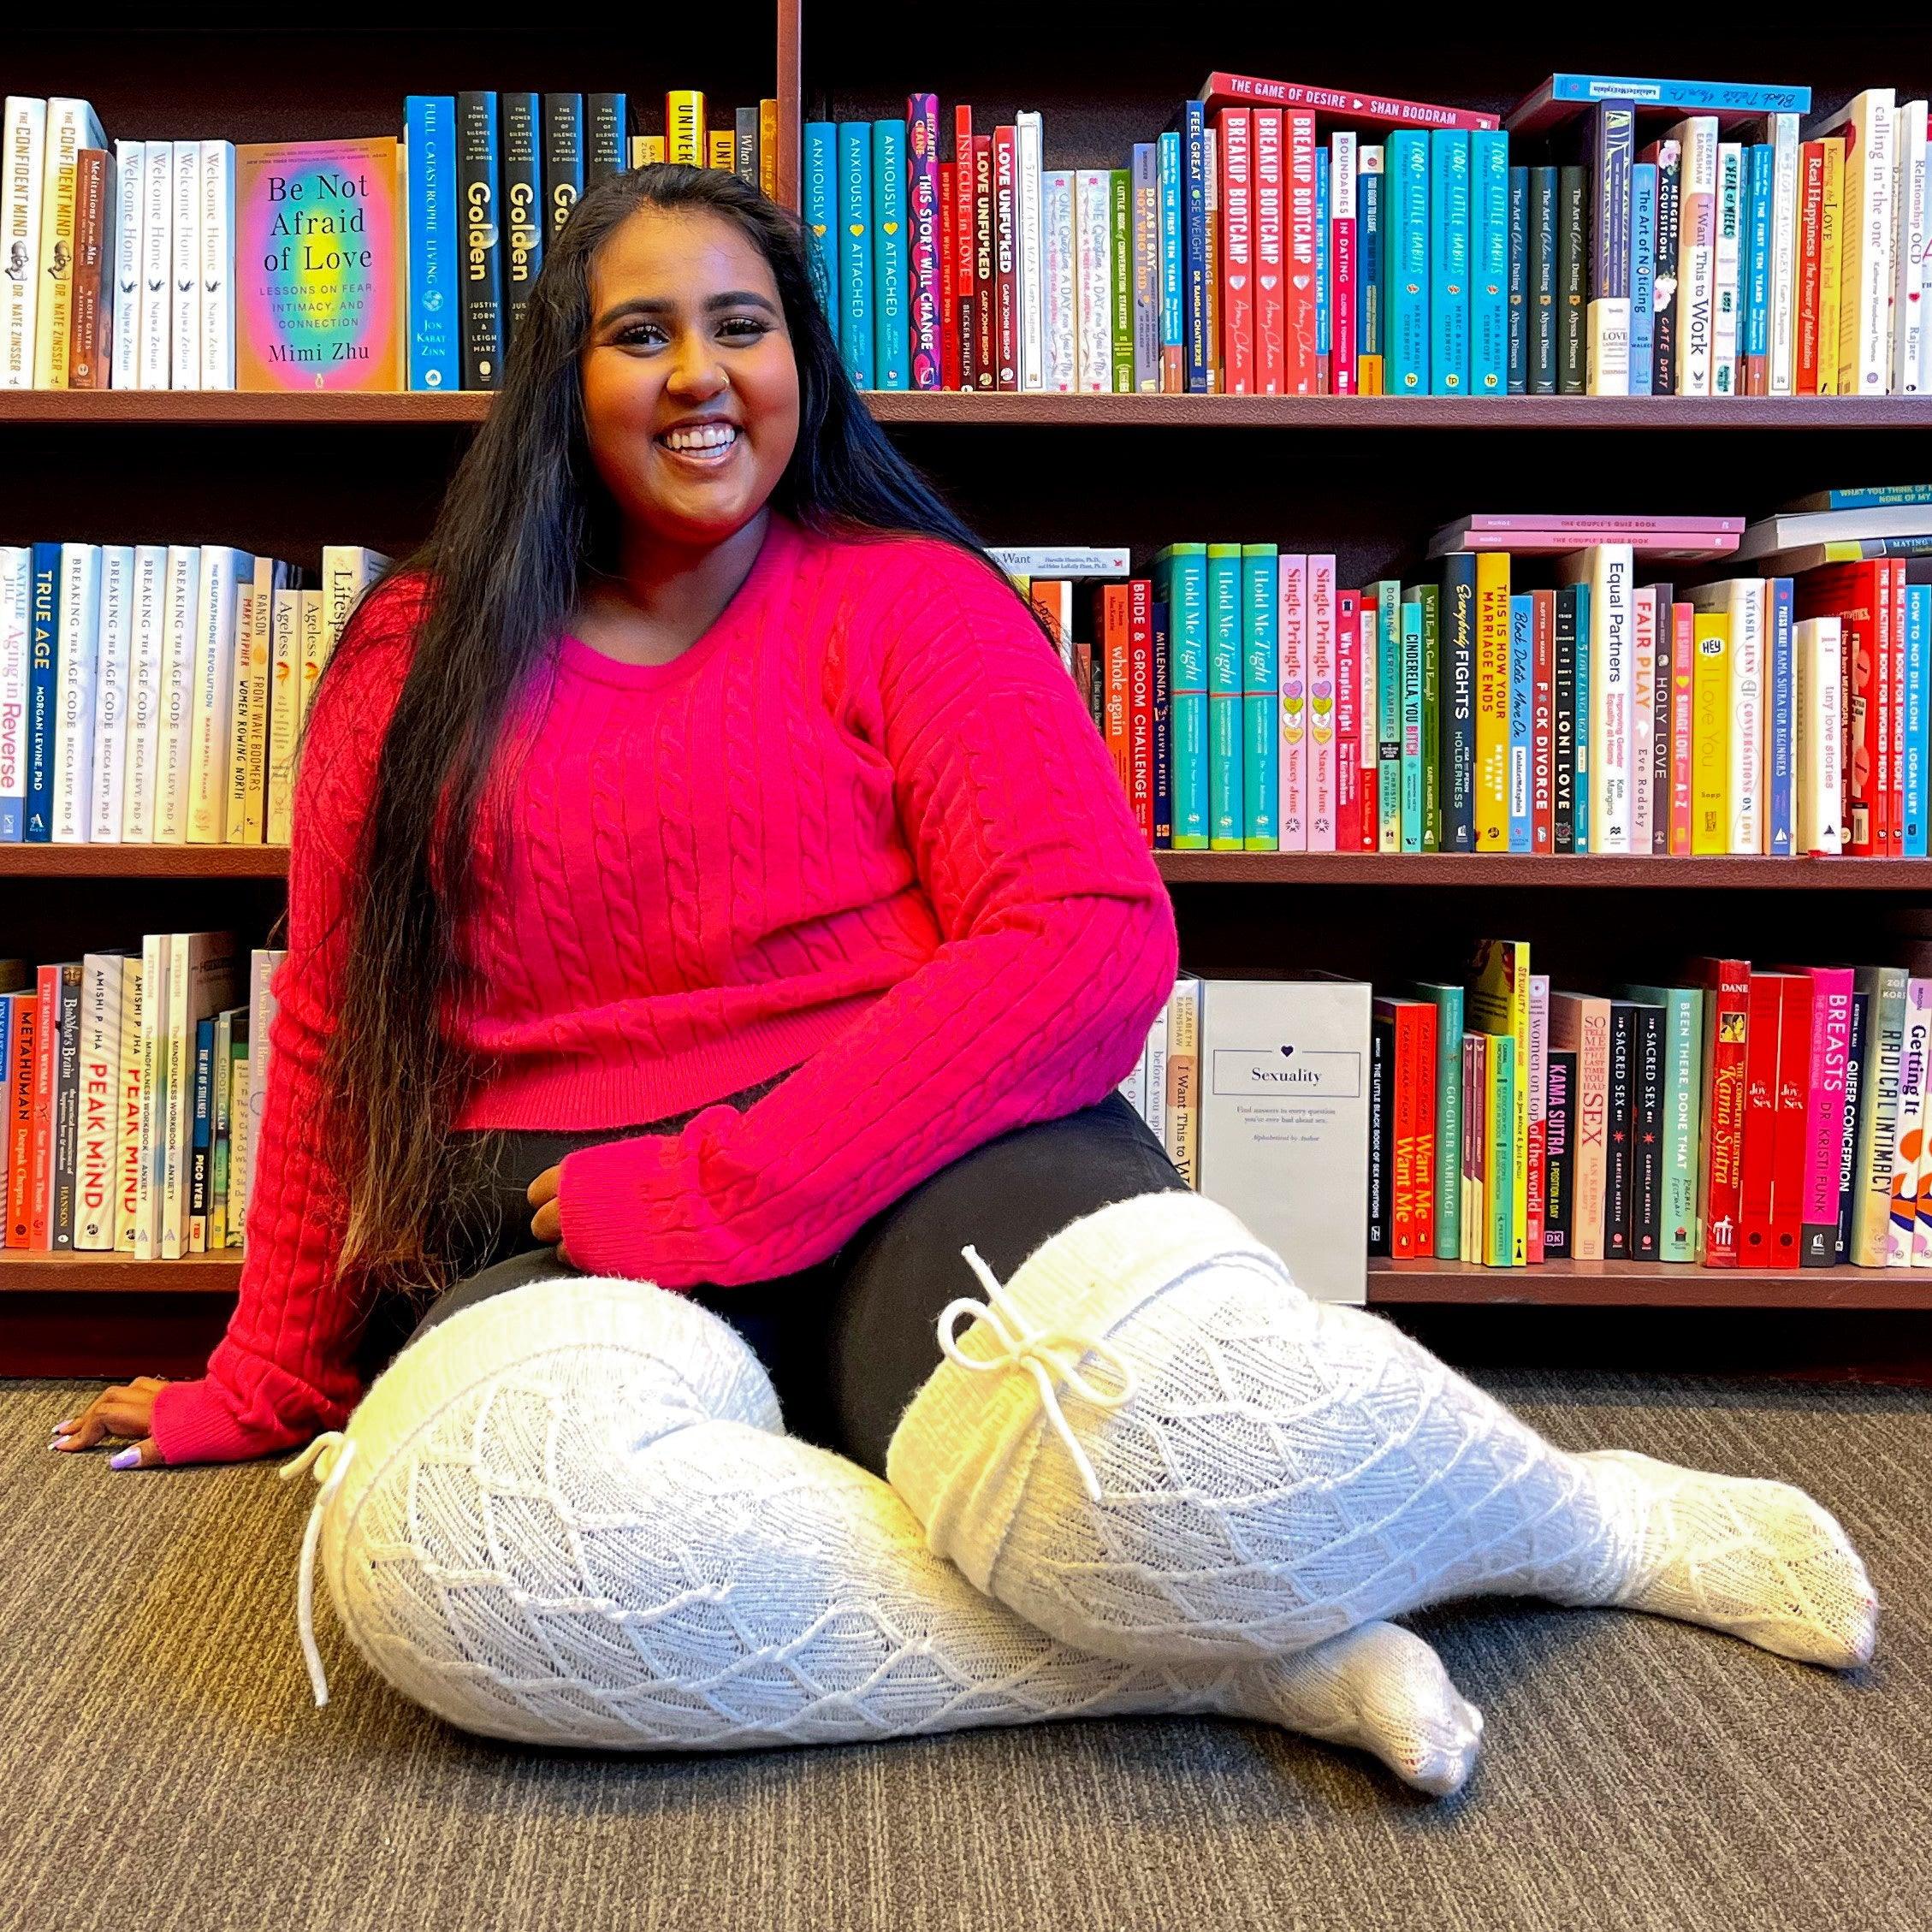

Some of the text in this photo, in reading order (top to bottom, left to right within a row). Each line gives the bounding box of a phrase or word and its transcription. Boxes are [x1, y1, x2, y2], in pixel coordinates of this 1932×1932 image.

[1231, 79, 1456, 124] THE GAME OF DESIRE SHAN BOODRAM
[14, 127, 31, 201] CONFIDENT
[884, 136, 895, 218] ANXIOUSLY
[977, 151, 988, 194] LOVE
[998, 144, 1010, 187] LOVE
[1190, 111, 1200, 180] FEEL GREAT
[13, 204, 27, 236] MIND
[270, 174, 369, 201] Be Not
[270, 209, 364, 235] Afraid
[425, 104, 437, 283] FULL CATASTROPHE LIVING
[957, 135, 971, 277] INSECURE in LOVE
[1227, 117, 1248, 264] BREAKUP BOOTCAMP
[1259, 117, 1278, 264] BREAKUP BOOTCAMP
[1293, 117, 1312, 264] BREAKUP BOOTCAMP
[1339, 138, 1348, 282] BOUNDARIES IN DATING
[1659, 177, 1668, 260] ACQUISITIONS
[1669, 185, 1678, 238] MERGERS
[1911, 160, 1924, 264] Relationship OCD
[264, 246, 371, 271] of Love
[468, 181, 499, 281] Golden
[511, 183, 541, 281] Golden
[850, 138, 863, 317] ANXIOUSLY ATTACHED
[920, 175, 933, 349] THIS STORY WILL CHANGE
[1697, 212, 1708, 247] Want
[260, 284, 376, 296] LESSONS ON FEAR,
[886, 242, 897, 317] ATTACHED
[1695, 285, 1704, 297] to
[1696, 252, 1707, 282] This
[9, 284, 23, 371] DR NATE ZINSSER
[273, 300, 364, 312] INTIMACY, AND
[279, 318, 359, 329] CONNECTION
[1661, 317, 1669, 351] CATE
[1691, 299, 1709, 355] Work
[270, 342, 369, 362] Mimi Zhu
[71, 559, 81, 626] BREAKING
[1004, 554, 1030, 563] Want
[34, 571, 52, 669] TRUE AGE
[278, 602, 292, 657] Ageless
[1133, 584, 1145, 625] BRIDE
[1284, 568, 1301, 678] Single Pringle
[1313, 568, 1330, 678] Single Pringle
[1608, 562, 1623, 682] Equal Partners
[68, 660, 77, 684] AGE
[1134, 649, 1145, 707] GROOM
[1482, 592, 1493, 712] MARRIAGE ENDS
[1496, 584, 1507, 719] THIS IS HOW YOUR
[1635, 602, 1651, 708] FAIR PLAY
[1702, 640, 1720, 654] HEY
[1909, 592, 1920, 732] HOW TO NOT DIE ALONE
[1, 625, 25, 788] Aging in Reverse
[67, 690, 76, 729] CODE
[1107, 646, 1127, 736] whole again
[1455, 650, 1468, 719] FIGHTS
[1135, 715, 1147, 798] CHALLENGE
[1558, 711, 1569, 809] LONI LOVE
[1655, 678, 1667, 779] HOLY LOVE
[1455, 732, 1463, 809] HOLDERNESS
[1536, 737, 1547, 810] DIVORCE
[1722, 983, 1748, 993] DANE
[19, 1011, 33, 1121] METAHUMAN
[1252, 1068, 1321, 1086] Sexuality
[1614, 1031, 1625, 1105] SACRED SEX
[1824, 995, 1846, 1091] BREASTS
[1901, 1025, 1926, 1116] Getting It
[87, 1064, 107, 1131] PEAK
[1528, 1019, 1542, 1213] women on top of the world
[1547, 1064, 1567, 1156] KAMA SUTRA
[1582, 1093, 1603, 1146] SEX
[1677, 1003, 1690, 1169] BEEN THERE, DONE THAT
[1871, 1030, 1900, 1195] RADICAL INTIMACY
[1396, 1137, 1414, 1188] Want
[1415, 1134, 1432, 1184] Want
[1814, 1101, 1832, 1212] DR KRISTI FUNK
[1839, 1060, 1858, 1192] QUEER CONCEPTION
[193, 1155, 204, 1208] PICO IYER
[1396, 1192, 1411, 1223] Me
[1415, 1189, 1431, 1219] Me
